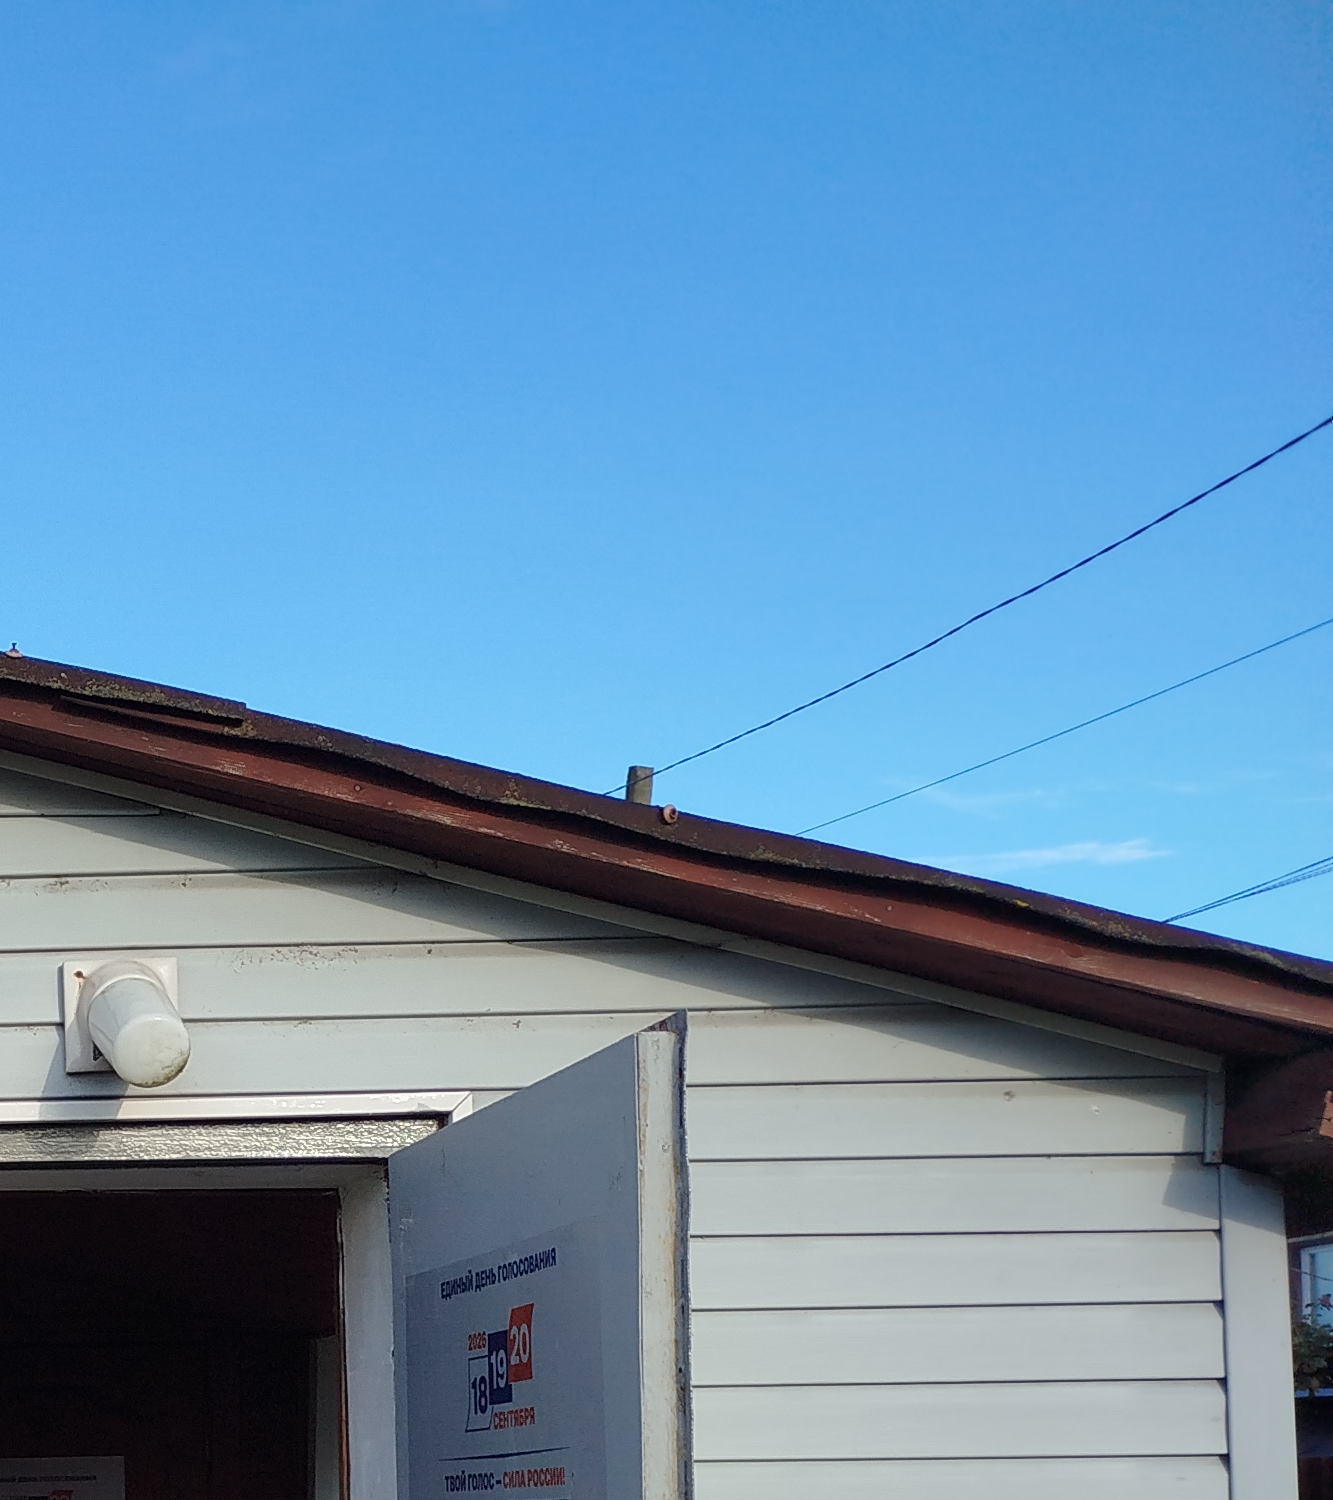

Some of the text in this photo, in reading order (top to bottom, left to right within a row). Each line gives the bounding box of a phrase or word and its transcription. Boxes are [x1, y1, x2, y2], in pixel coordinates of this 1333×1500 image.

[440, 1247, 557, 1300] ЕДИНЫЙ ДЕНЬ ГОЛОСОВАНИЯ
[471, 1323, 530, 1415] 18 19 20
[493, 1406, 536, 1430] СЕНТЯБРЯ
[444, 1470, 467, 1492] ТВОЙ
[467, 1471, 495, 1491] ГОЛОС
[503, 1470, 527, 1489] СИЛА
[528, 1467, 566, 1487] РОССИИ!
